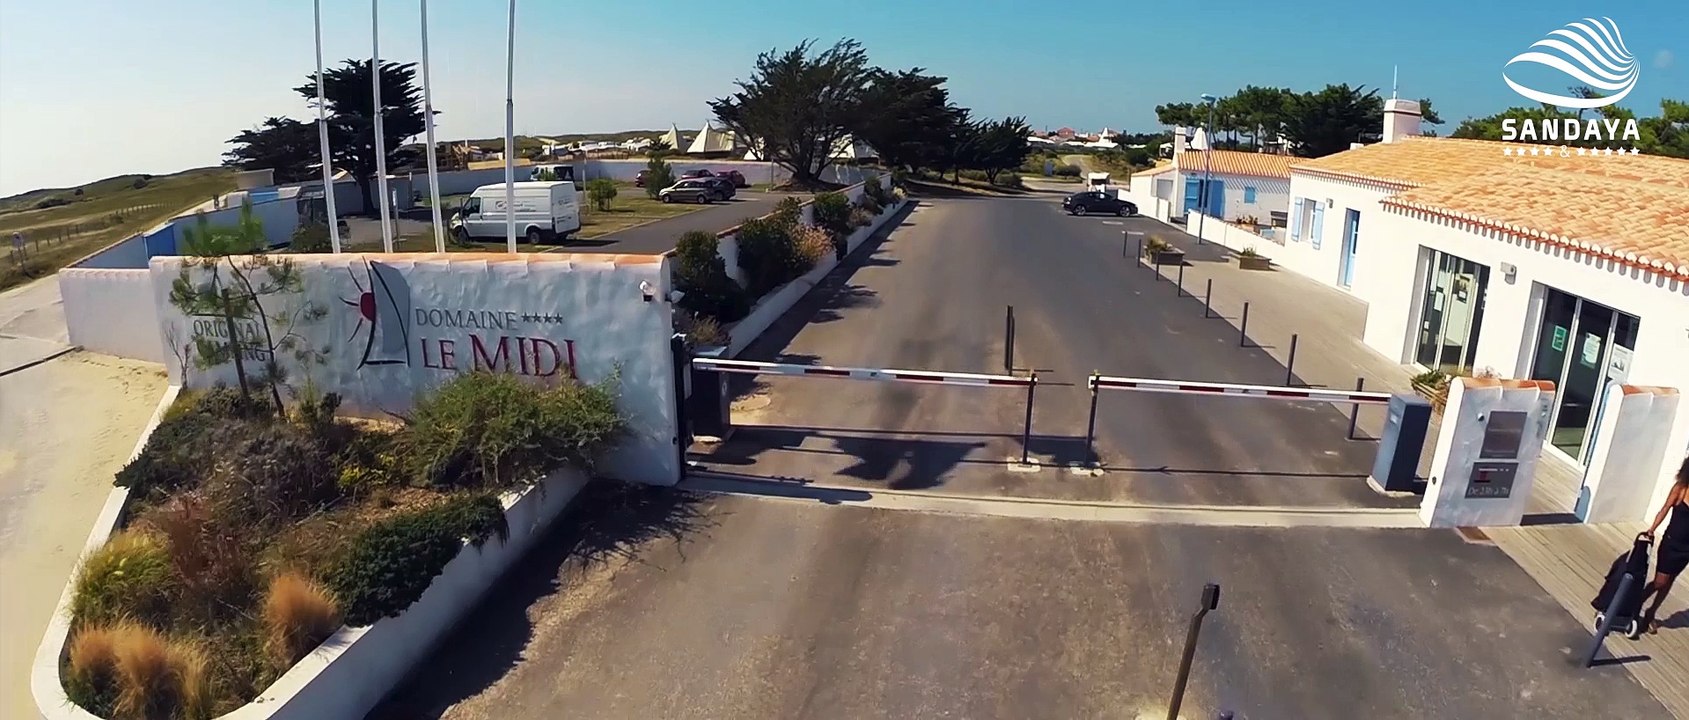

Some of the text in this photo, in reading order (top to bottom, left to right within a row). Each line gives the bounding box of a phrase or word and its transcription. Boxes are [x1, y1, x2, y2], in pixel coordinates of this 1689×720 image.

[415, 308, 518, 332] DOMAINE
[421, 334, 579, 380] LE MIDI
